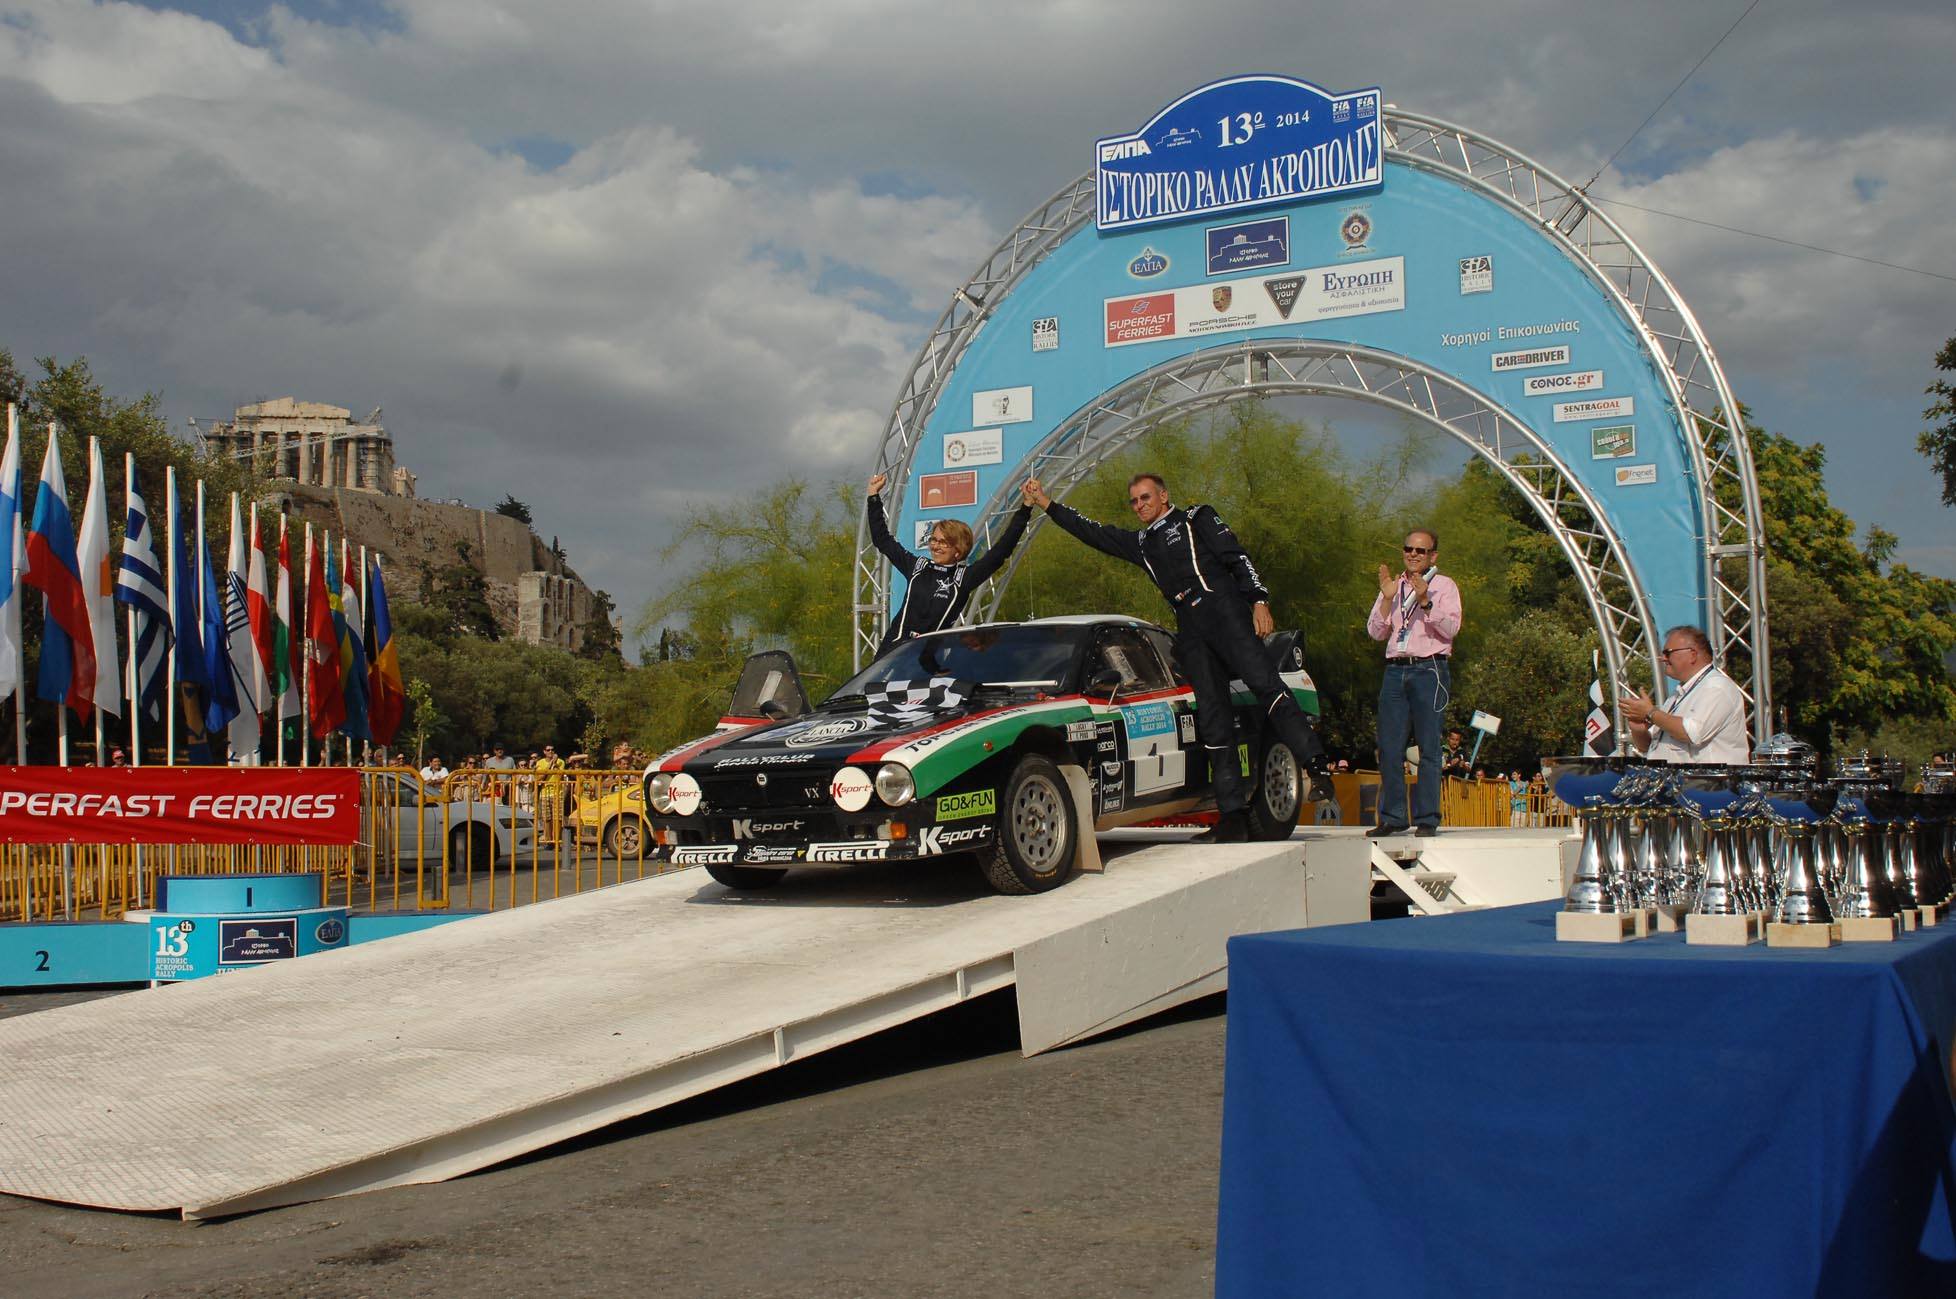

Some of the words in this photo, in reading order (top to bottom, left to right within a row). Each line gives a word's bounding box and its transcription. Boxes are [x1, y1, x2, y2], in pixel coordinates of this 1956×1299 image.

[1333, 101, 1350, 112] FIA
[1357, 97, 1374, 107] FIA
[1276, 110, 1310, 128] 2014
[1101, 139, 1152, 163] ΕΛΠΑ
[1100, 167, 1191, 223] ΙΣΤΟΡΙΚΟ
[1196, 162, 1255, 209] ΡΑΛΛΥ
[1258, 121, 1379, 199] ΑΚΡΟΠΟΛΙΣ
[1134, 260, 1162, 274] ΕΛΠΑ
[1273, 281, 1298, 291] store
[1322, 270, 1393, 292] ΕΥΡΩΠΗ
[1276, 290, 1295, 300] your
[1330, 286, 1385, 299] ΑΣΦΑΛΙΣΤΙΚΗ
[1109, 312, 1173, 331] SUPERFAST
[1190, 313, 1257, 327] PORSCHE
[1117, 325, 1163, 340] FERRIES
[1441, 328, 1491, 346] Χορηγοί
[1498, 318, 1580, 340] Επικοινωνίας
[1496, 355, 1517, 367] CAR
[1525, 350, 1565, 364] DRIVER
[1564, 400, 1620, 413] SENTRAGOAL
[0, 791, 176, 817] PERFAST
[188, 794, 337, 819] FERRIES
[940, 791, 993, 812] GO&FUN
[671, 844, 739, 865] PIRELLI
[805, 840, 890, 863] PIRELLI
[247, 887, 253, 907] 1
[35, 950, 50, 972] 2
[155, 957, 188, 965] HISTORIC
[155, 964, 194, 972] ACROPOLIS
[155, 970, 177, 979] RALLY
